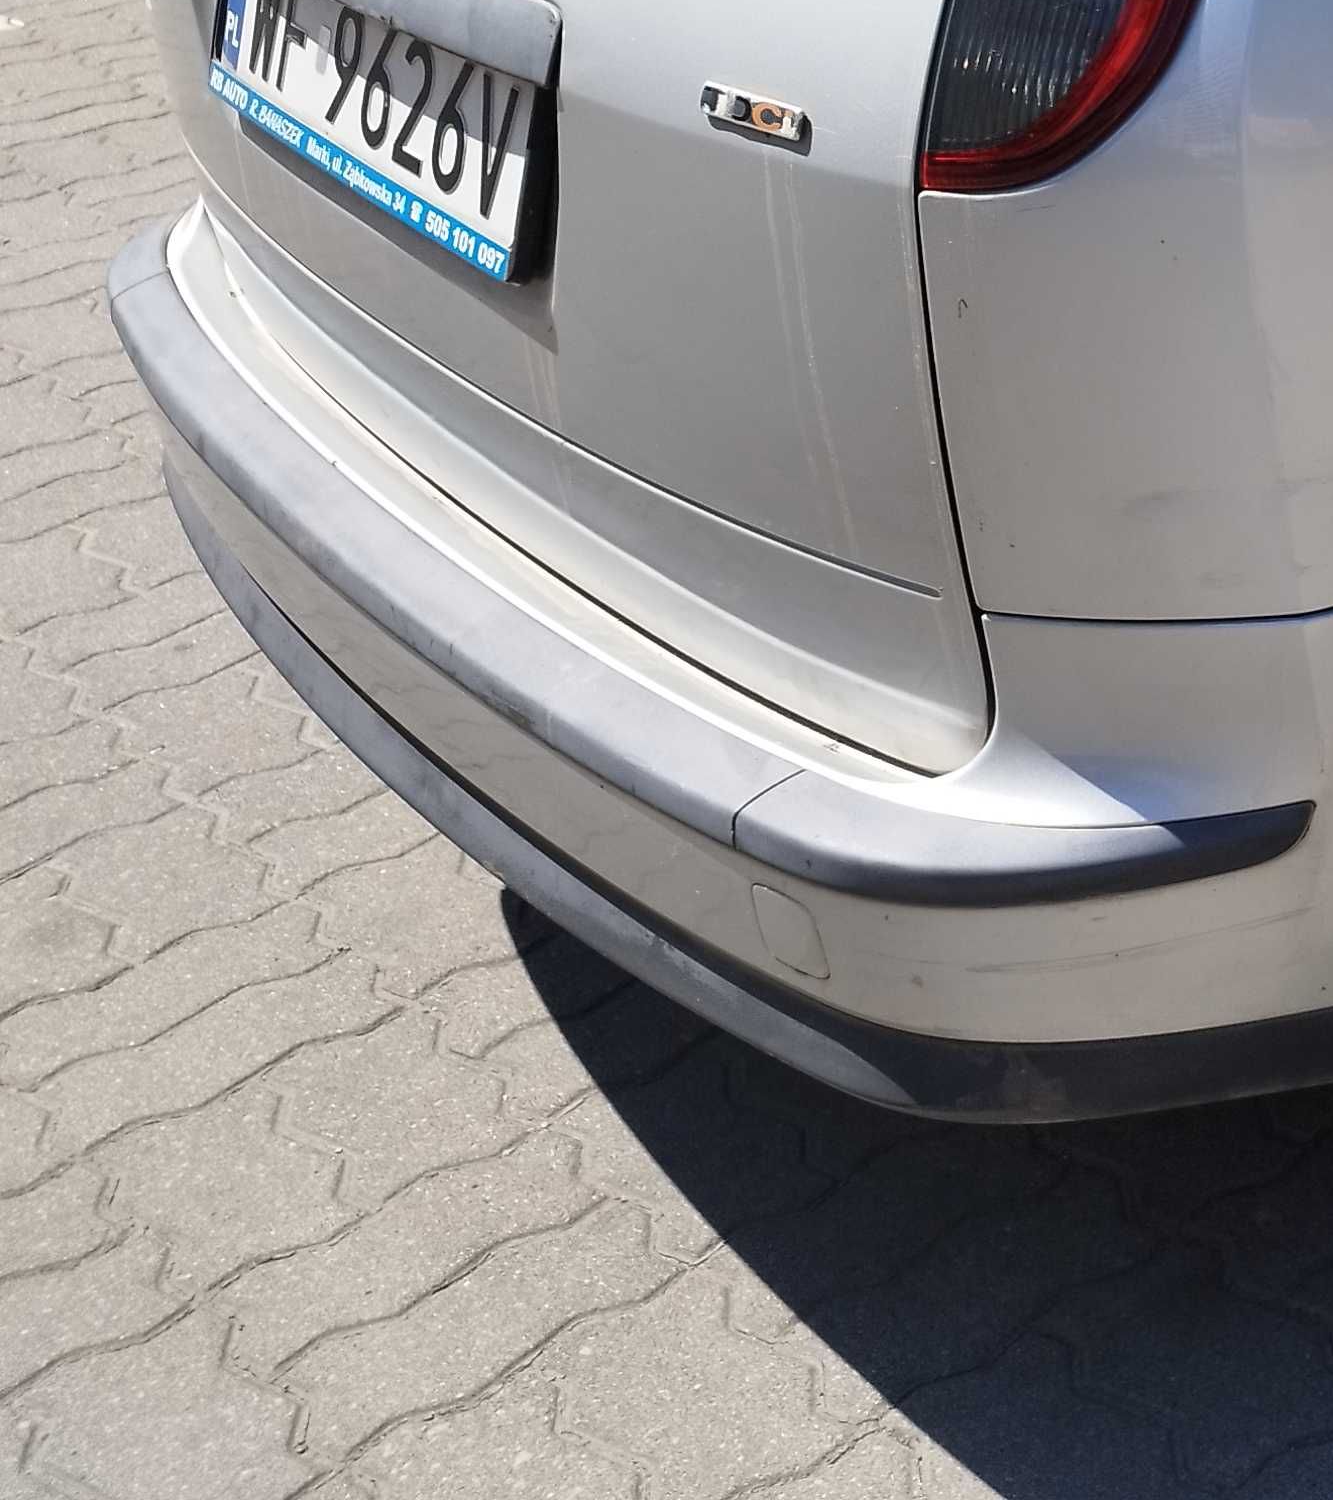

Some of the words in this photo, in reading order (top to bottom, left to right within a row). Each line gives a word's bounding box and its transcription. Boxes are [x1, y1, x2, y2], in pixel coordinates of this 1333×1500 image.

[225, 9, 240, 49] PL
[325, 5, 520, 220] 9626V
[210, 66, 225, 92] RB
[222, 77, 249, 111] AUTO
[392, 191, 407, 214] 34
[425, 209, 451, 242] 505
[452, 226, 476, 258] 101
[477, 242, 506, 274] 097
